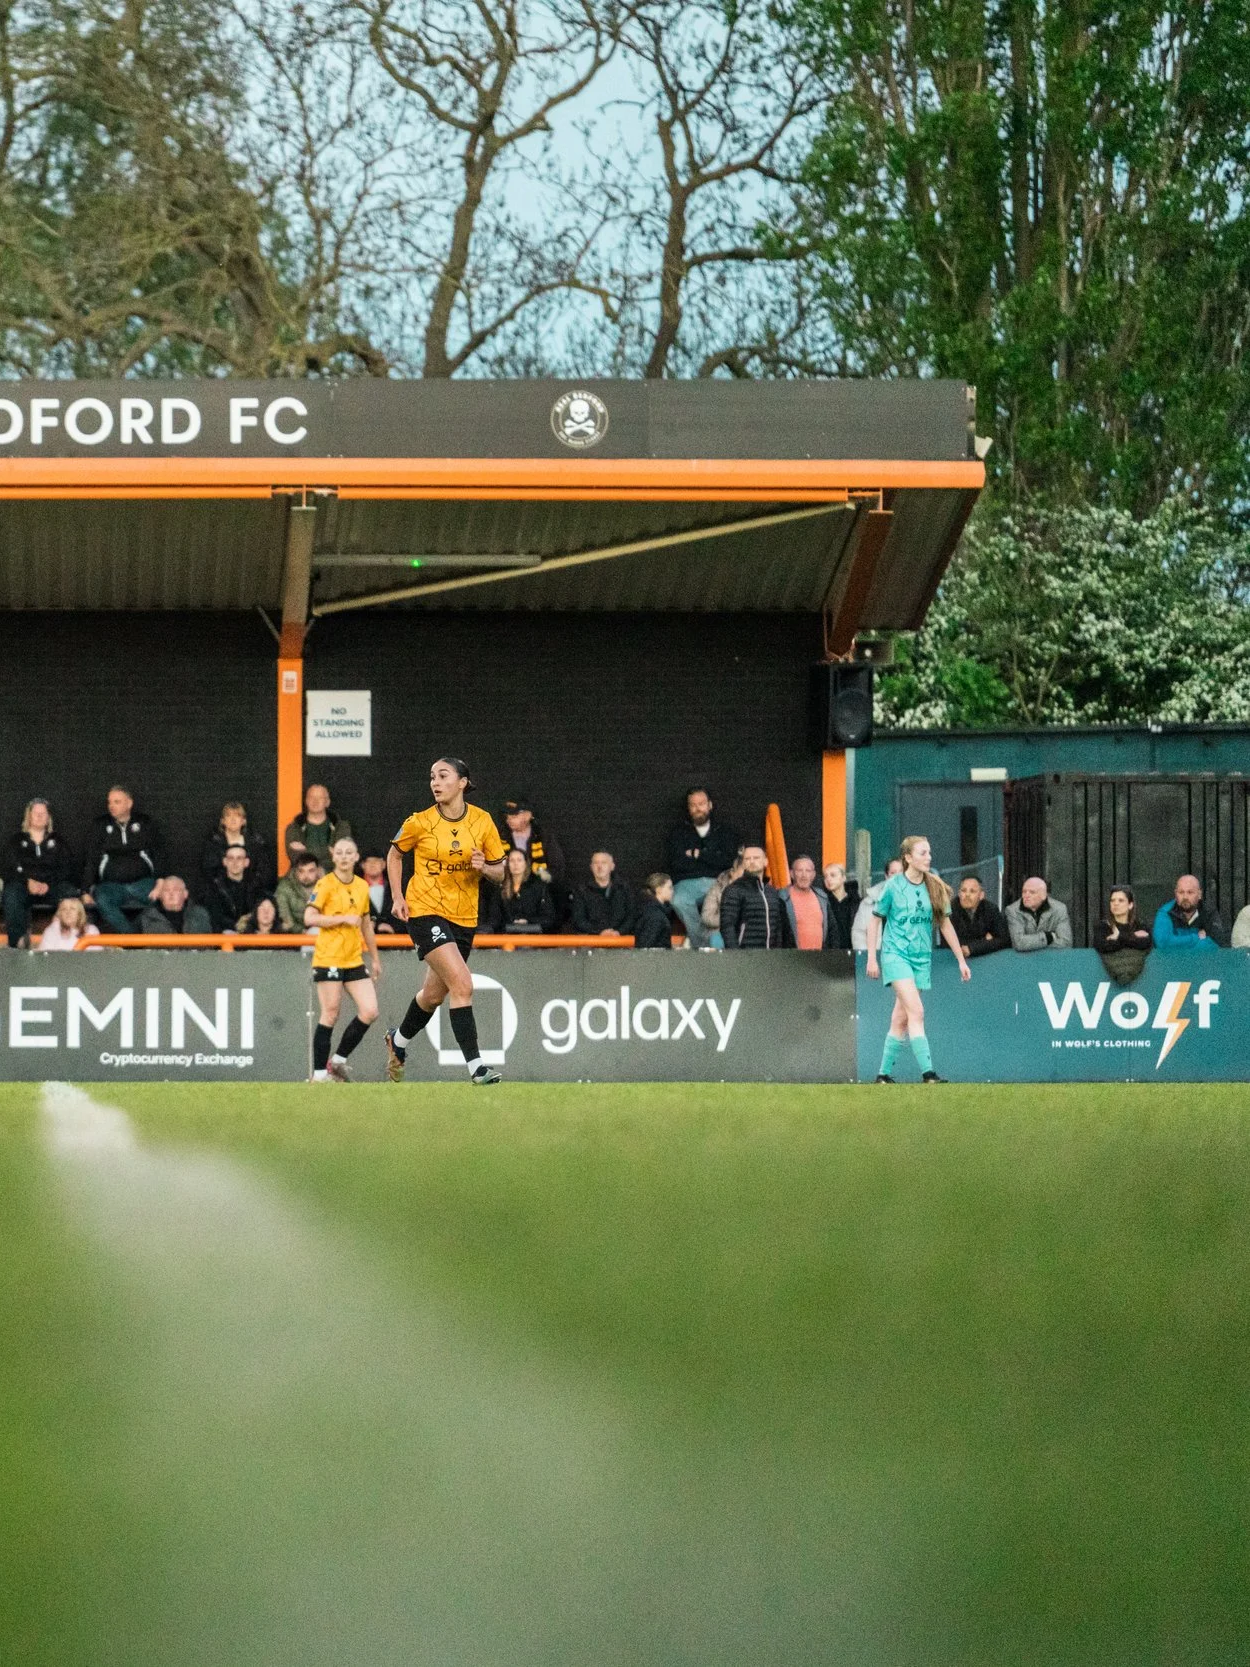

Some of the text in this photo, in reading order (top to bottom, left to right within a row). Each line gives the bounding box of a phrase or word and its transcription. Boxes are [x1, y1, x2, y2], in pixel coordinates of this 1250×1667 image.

[229, 397, 308, 444] FC
[331, 707, 347, 715] NO
[312, 718, 365, 727] STANDING
[315, 730, 364, 738] ALLOWED
[447, 861, 471, 874] gala
[540, 985, 742, 1054] galaxy
[1038, 979, 1221, 1069] Wolf
[1051, 1040, 1062, 1048] IN
[1065, 1040, 1101, 1048] WOLF'S
[99, 1052, 254, 1068] Cryptocurrency Exchange
